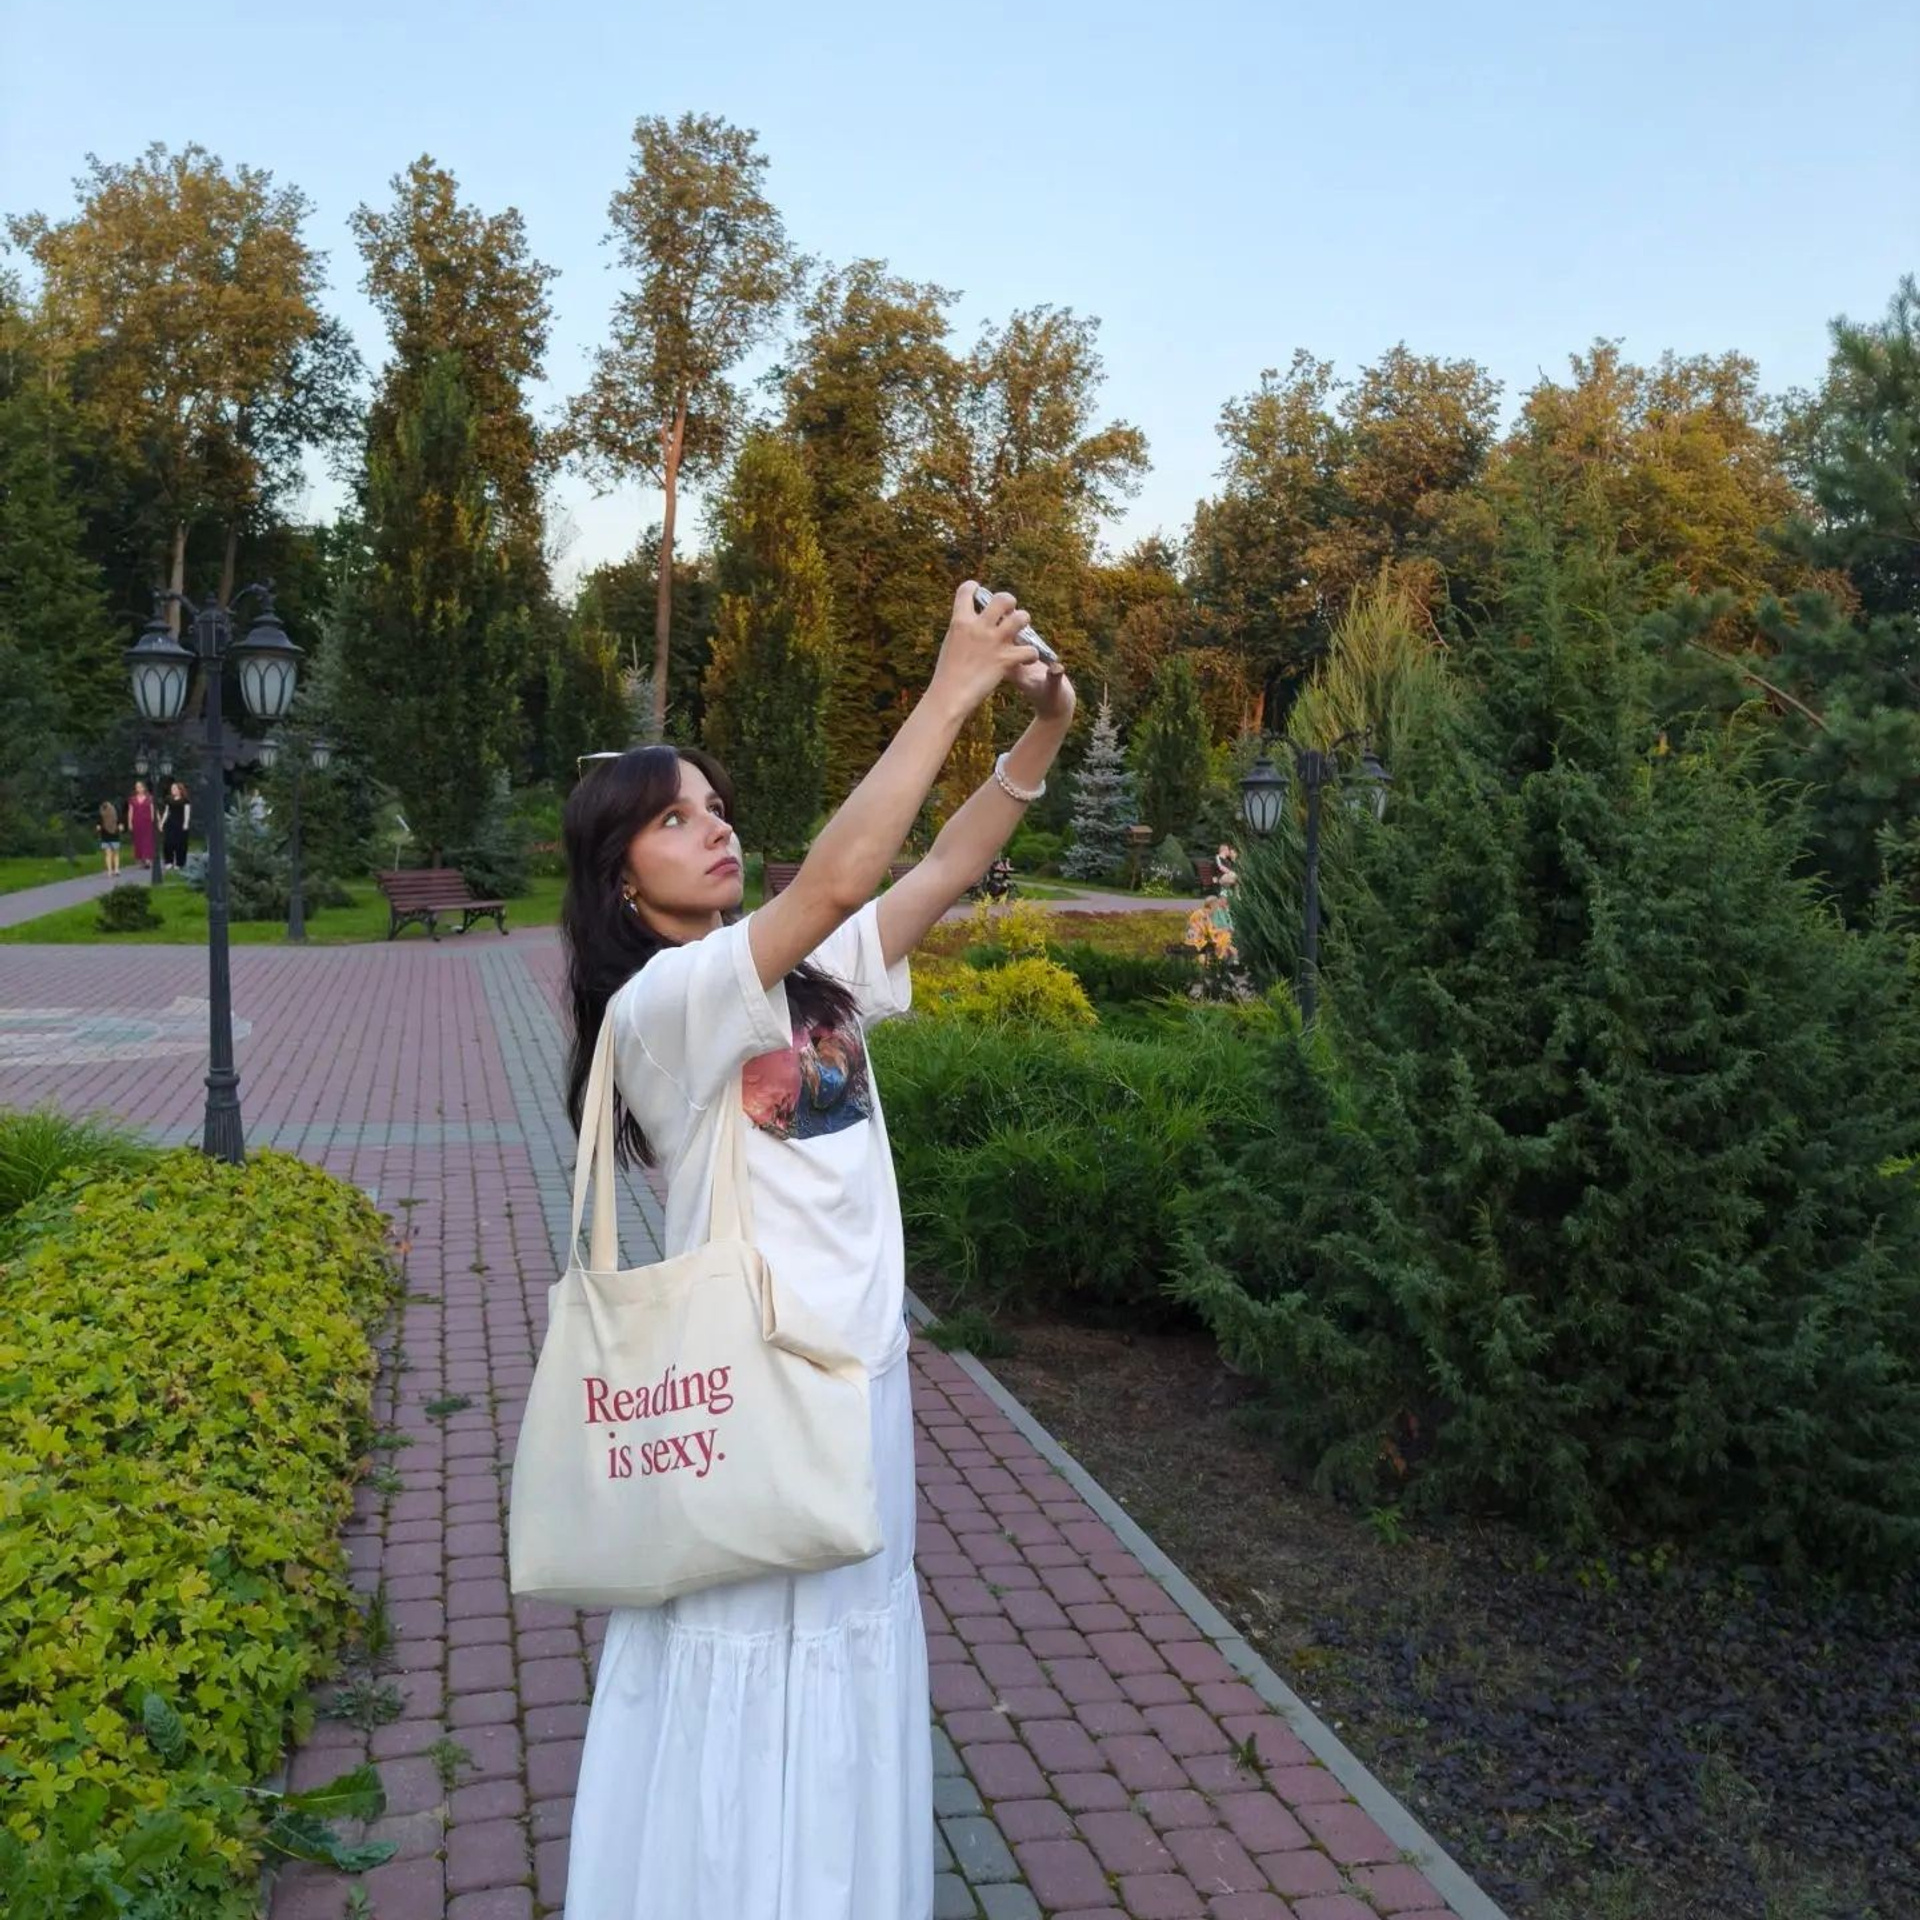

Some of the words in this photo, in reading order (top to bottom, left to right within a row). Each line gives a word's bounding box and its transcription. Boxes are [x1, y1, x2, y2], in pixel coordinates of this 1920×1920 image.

[582, 1363, 734, 1424] Reading
[608, 1431, 633, 1479] is
[641, 1428, 726, 1478] sexy.
